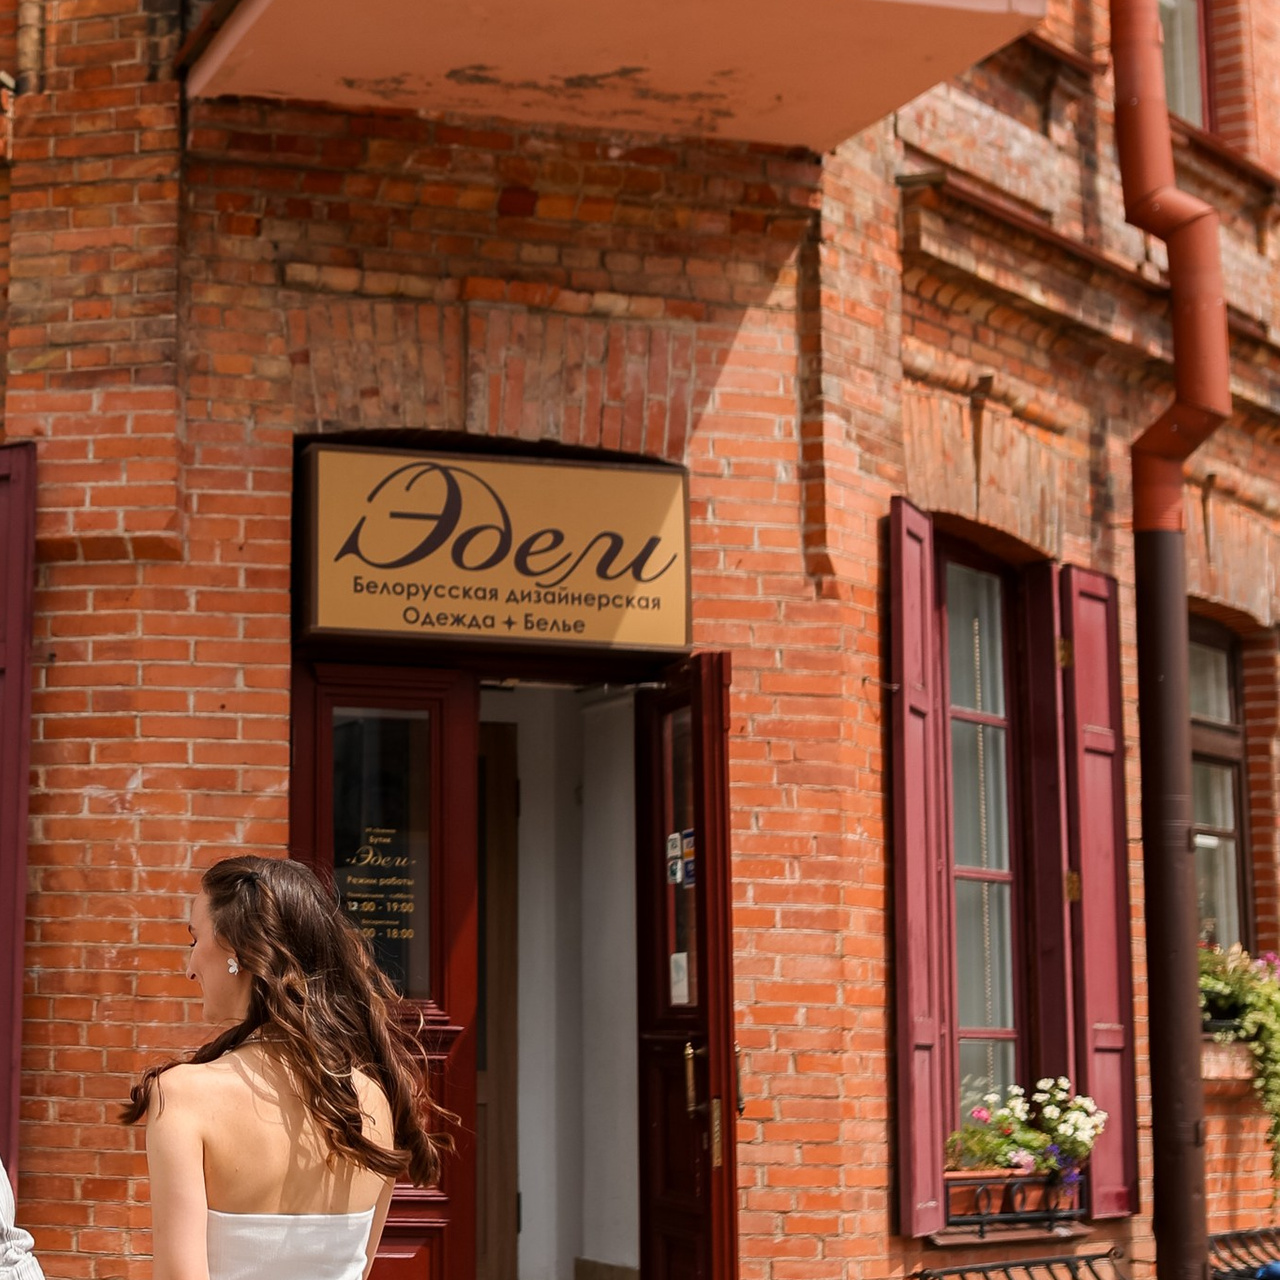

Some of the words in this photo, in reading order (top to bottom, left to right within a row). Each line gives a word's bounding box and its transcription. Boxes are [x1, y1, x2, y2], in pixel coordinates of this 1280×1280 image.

[334, 461, 677, 588] Эдем
[352, 575, 499, 603] Белорусская
[505, 585, 661, 612] дизайнерская
[402, 606, 496, 630] Одежда
[523, 612, 586, 634] Белье
[386, 901, 415, 913] 19:00
